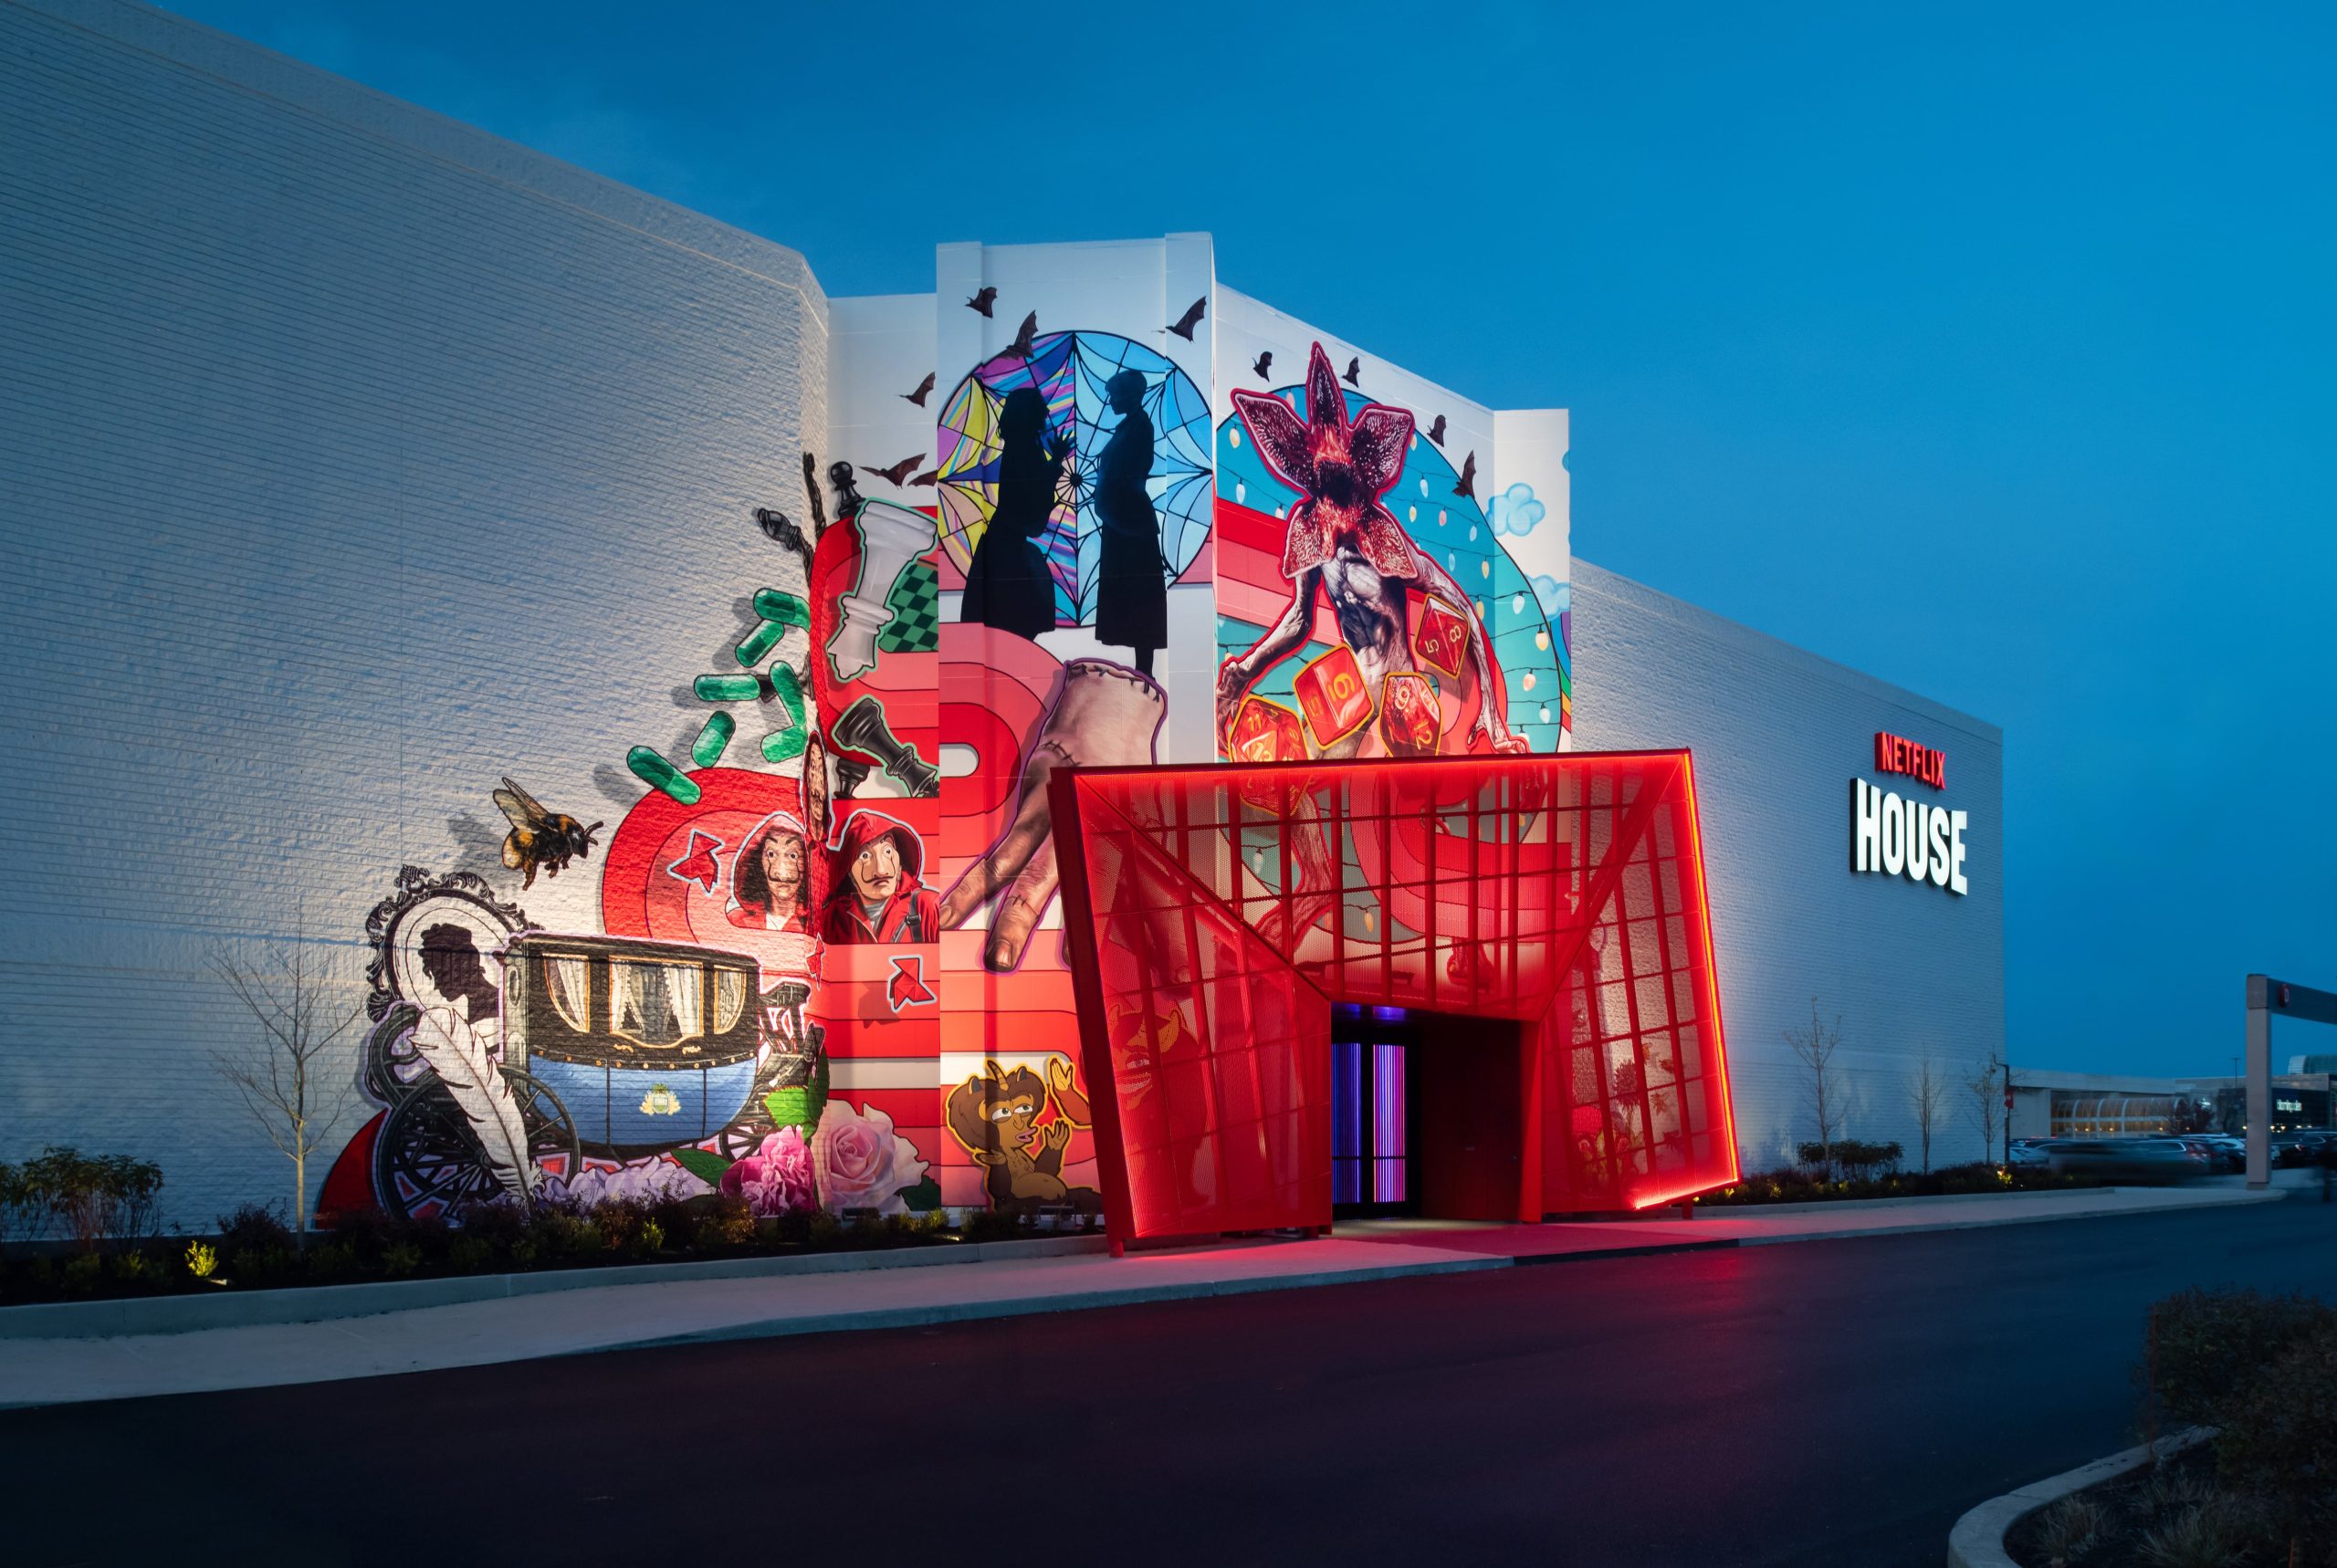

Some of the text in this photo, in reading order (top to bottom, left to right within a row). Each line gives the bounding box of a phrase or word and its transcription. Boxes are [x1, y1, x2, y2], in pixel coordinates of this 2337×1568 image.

[1425, 639, 1440, 653] 5
[1450, 625, 1461, 643] 8
[1247, 713, 1262, 731] 11
[1413, 718, 1432, 750] 12
[1877, 731, 1945, 789] NETFLIX
[1851, 777, 1967, 895] HOUSE
